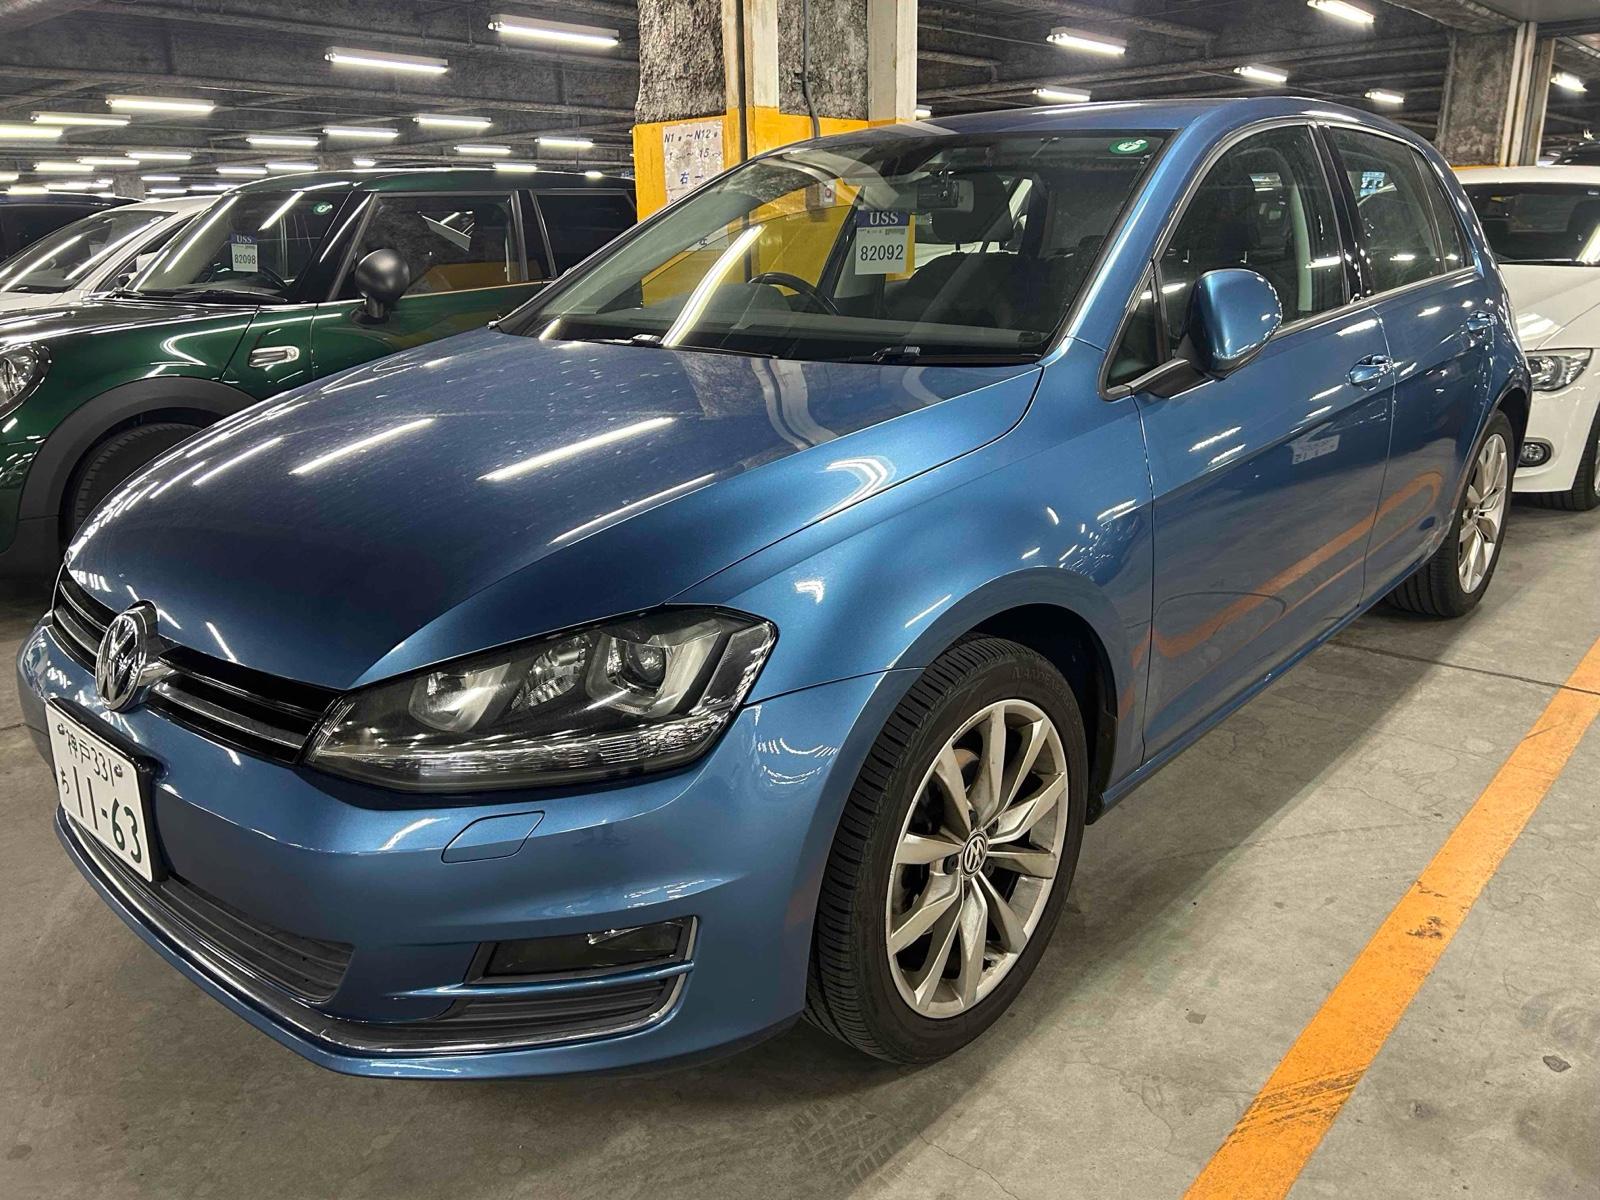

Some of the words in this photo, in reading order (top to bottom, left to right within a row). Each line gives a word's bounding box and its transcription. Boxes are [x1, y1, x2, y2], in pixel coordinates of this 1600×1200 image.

[680, 171, 689, 184] 右
[869, 211, 899, 225] USS
[236, 234, 252, 244] USS
[860, 244, 904, 261] 82092
[234, 254, 256, 265] 82098
[73, 765, 142, 864] 11-63
